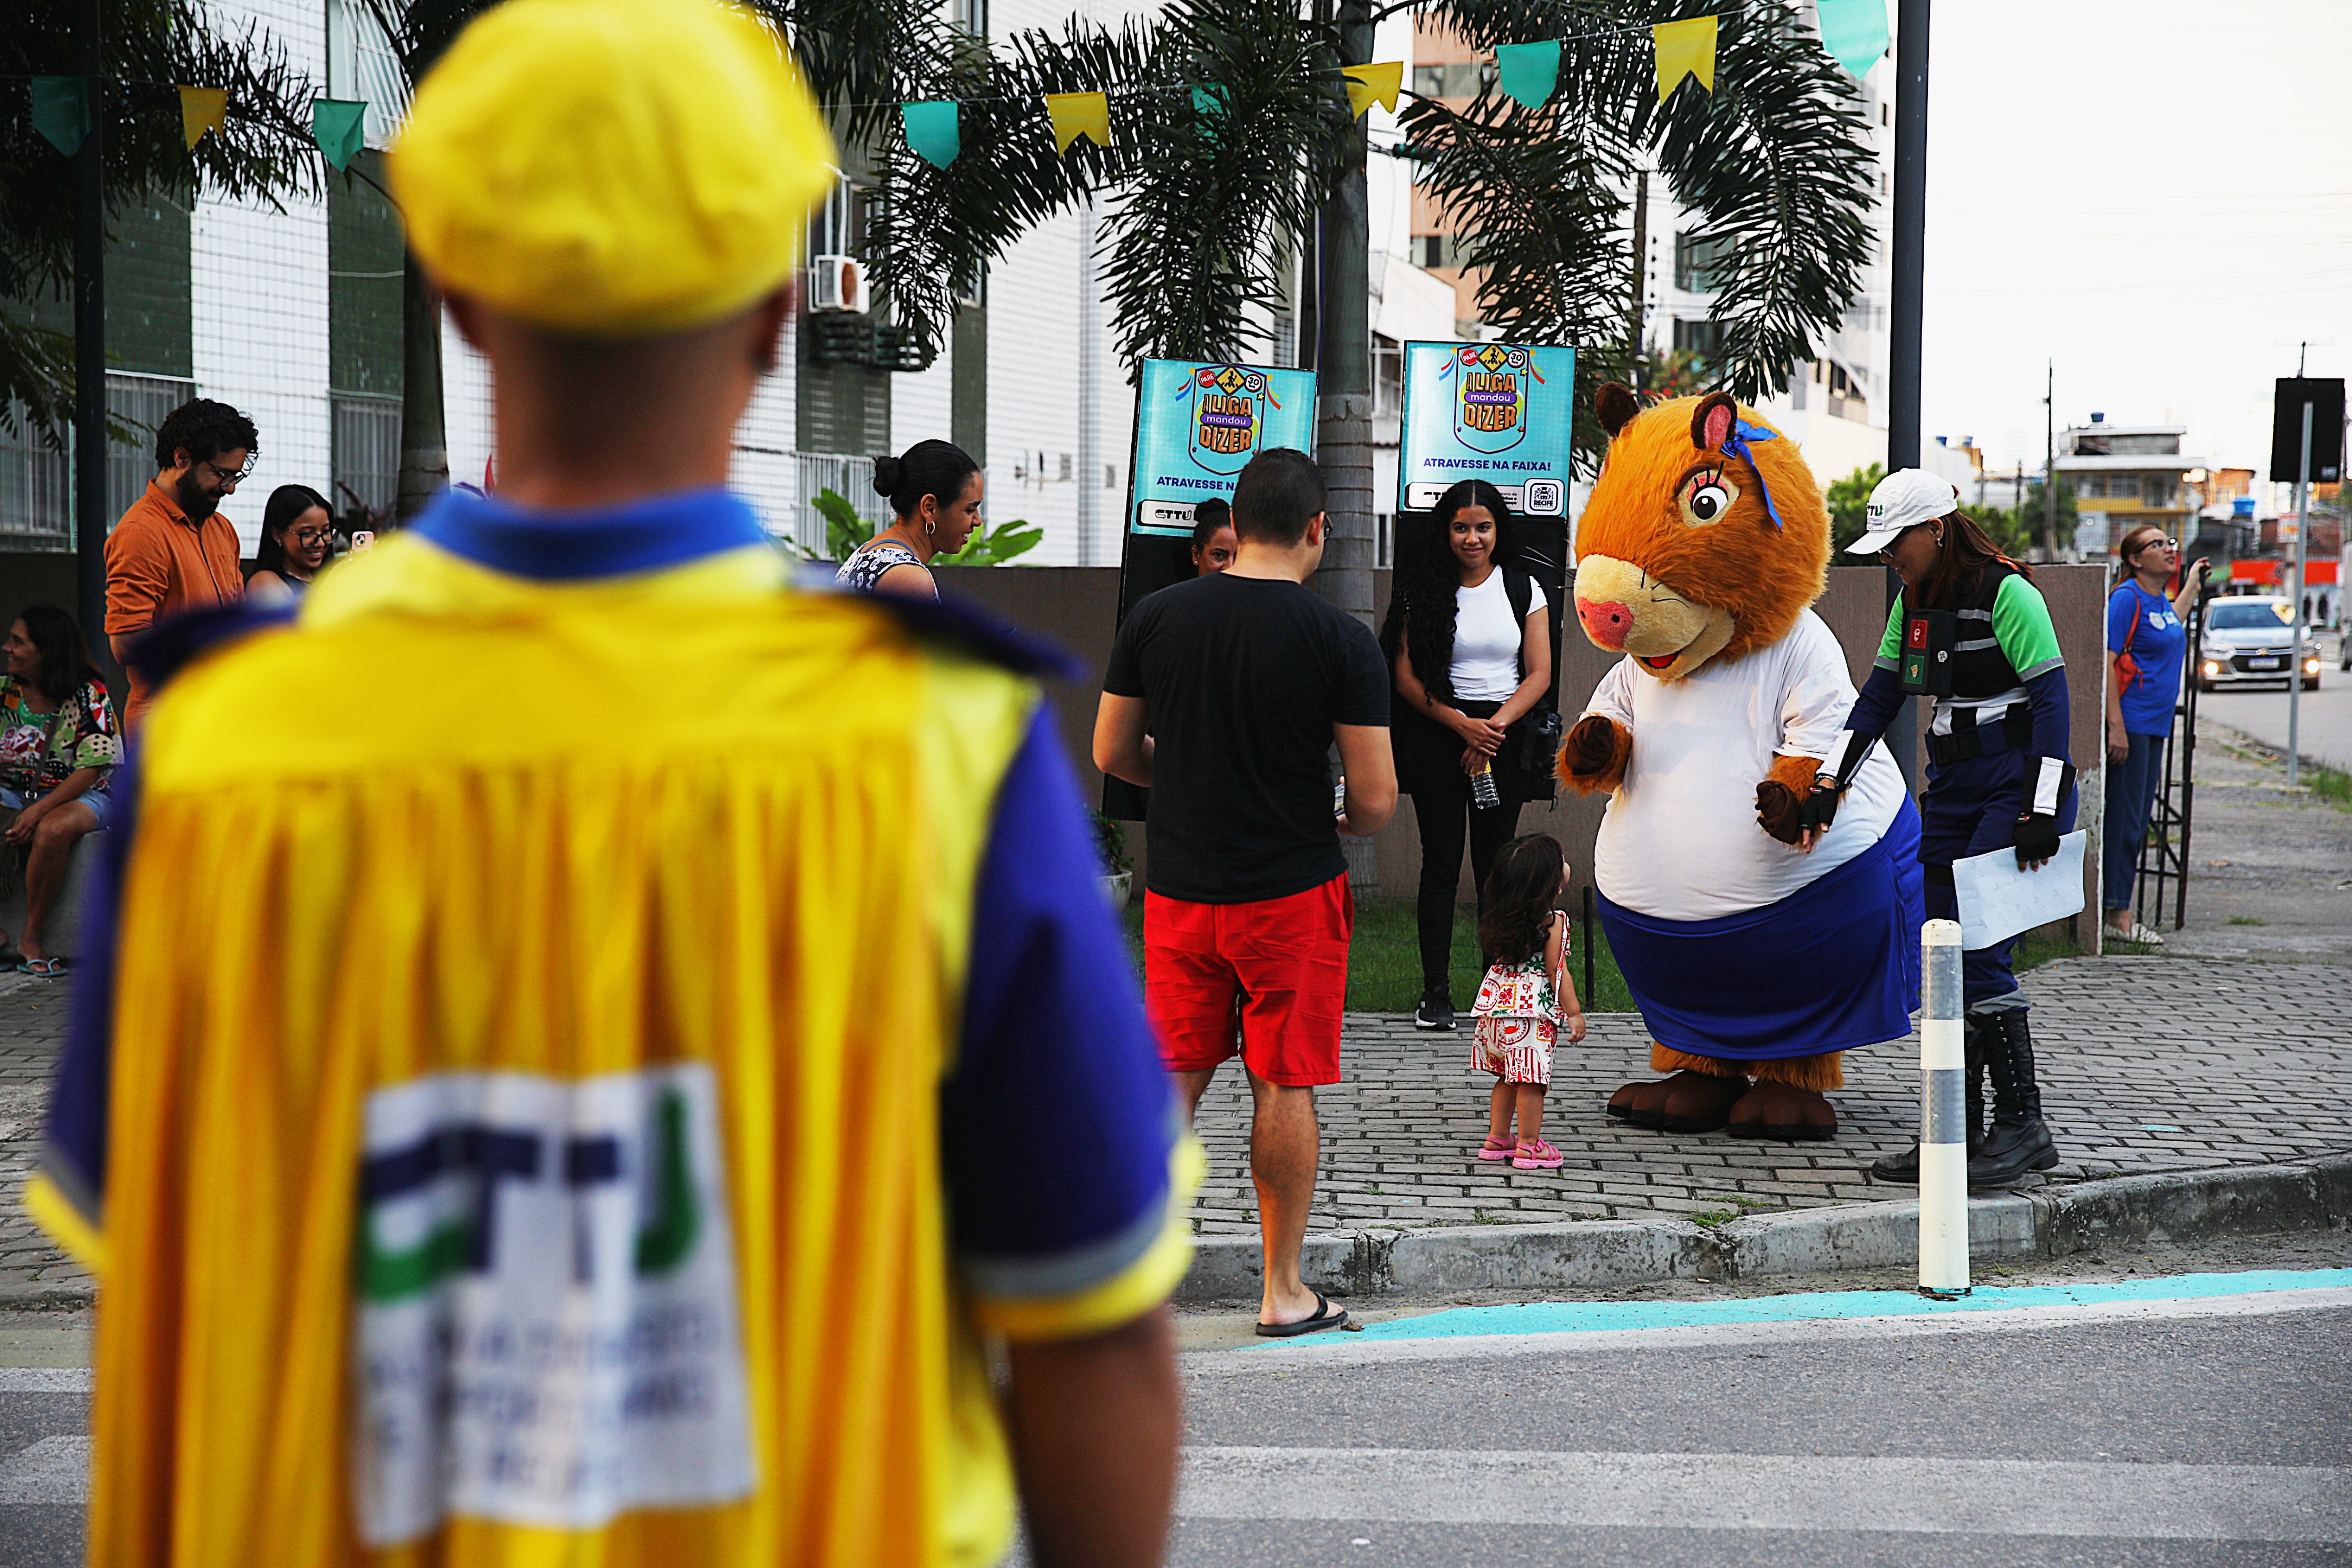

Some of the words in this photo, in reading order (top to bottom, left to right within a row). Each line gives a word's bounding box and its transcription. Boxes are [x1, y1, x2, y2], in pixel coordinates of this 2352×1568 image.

[1463, 351, 1477, 362] PARE
[1510, 353, 1522, 361] 30
[1200, 374, 1214, 383] PARE
[1466, 373, 1473, 391] A
[1475, 373, 1516, 393] LIGA
[1471, 393, 1510, 402] mandou
[1202, 394, 1210, 413] A
[1211, 395, 1253, 417] LIGA
[1207, 416, 1246, 425] mandou
[1464, 404, 1517, 432] DIZER
[1199, 425, 1252, 454] DIZER
[1424, 458, 1489, 469] ATRAVESSE
[1492, 460, 1510, 469] NA
[1512, 461, 1551, 471] FAIXA!
[1157, 476, 1223, 490] ATRAVESSE
[1226, 482, 1236, 491] N
